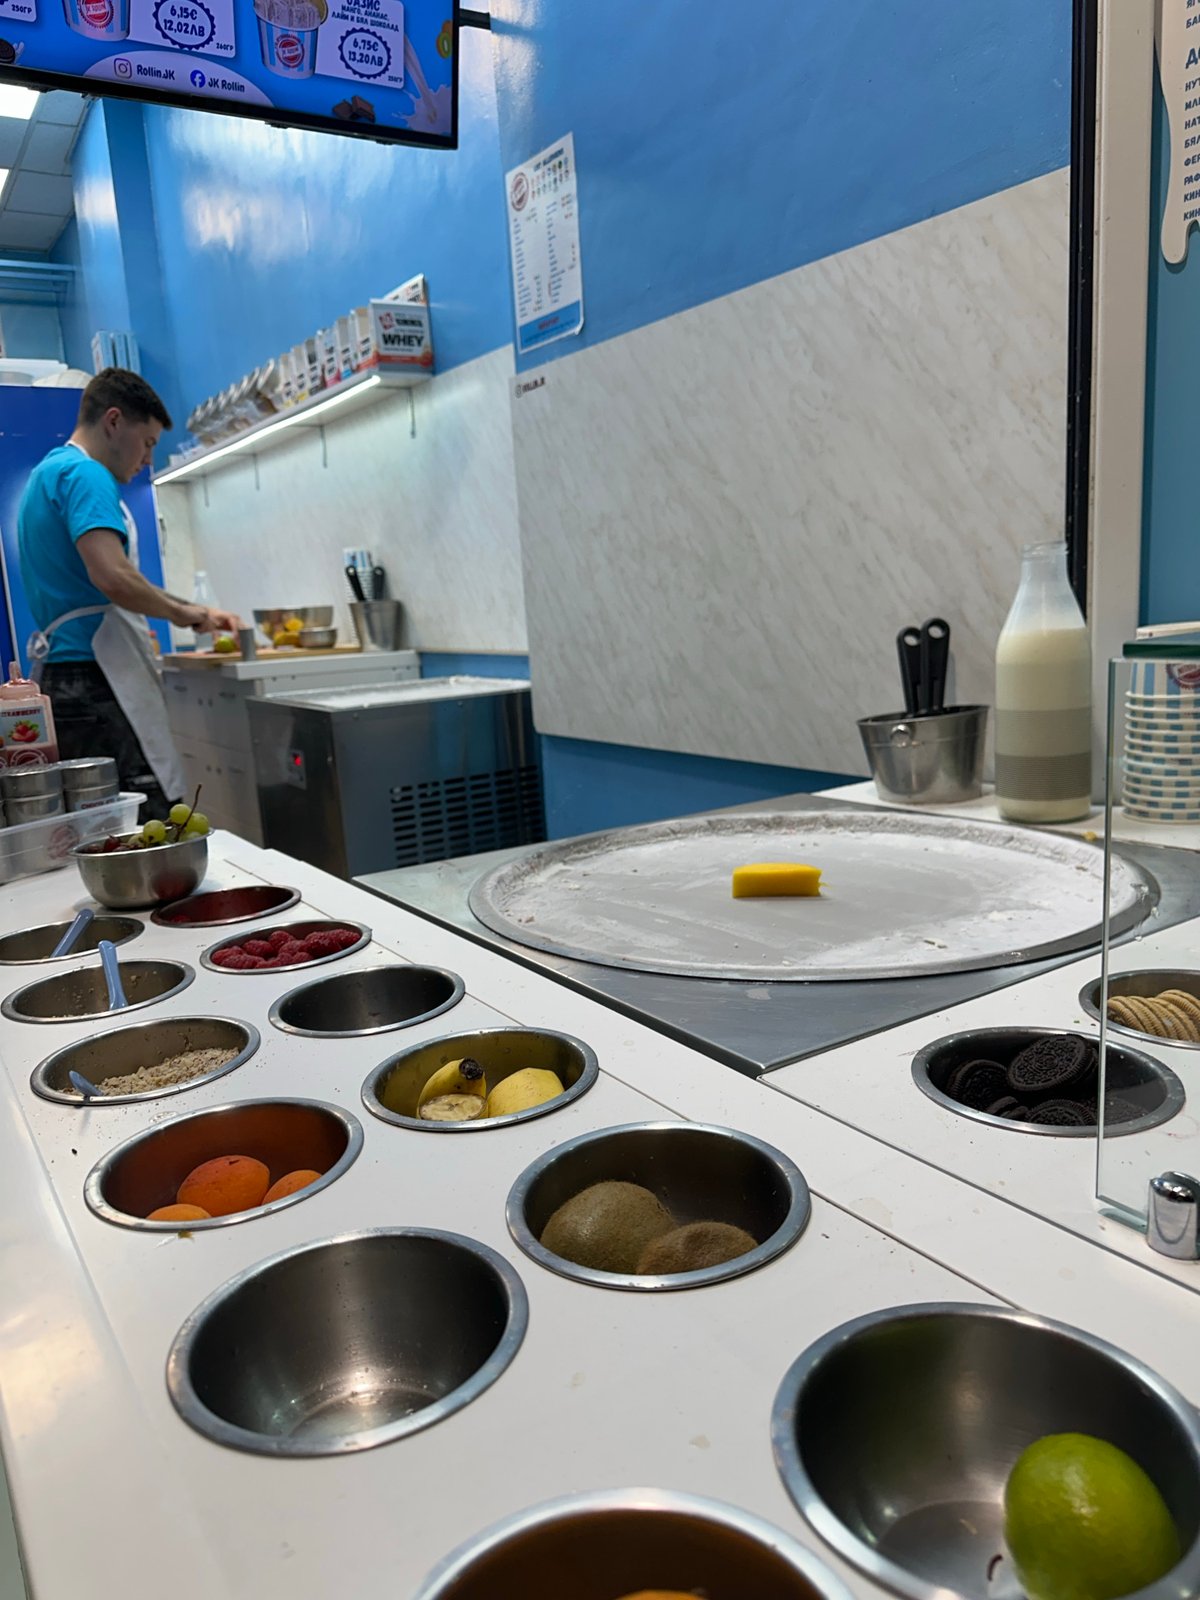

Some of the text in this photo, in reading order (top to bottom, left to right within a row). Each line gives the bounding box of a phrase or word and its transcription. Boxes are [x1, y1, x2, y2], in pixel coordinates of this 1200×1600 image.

[11, 4, 32, 14] 250ГР
[170, 5, 197, 20] 6,15€
[163, 19, 205, 37] 12,02ЛВ
[1186, 47, 1200, 69] Д
[208, 77, 245, 92] JK Rollin
[382, 332, 424, 348] WHEY
